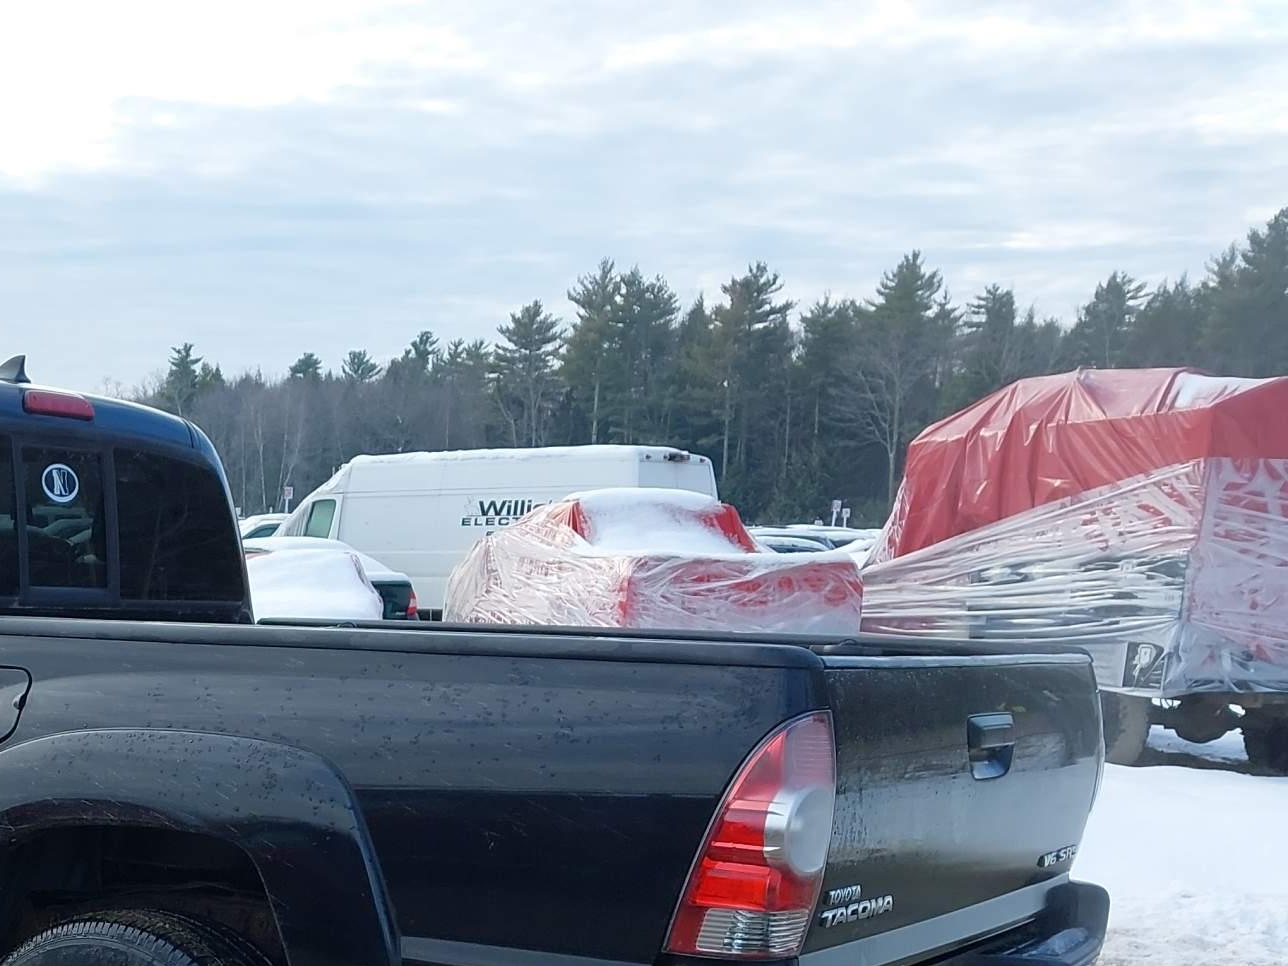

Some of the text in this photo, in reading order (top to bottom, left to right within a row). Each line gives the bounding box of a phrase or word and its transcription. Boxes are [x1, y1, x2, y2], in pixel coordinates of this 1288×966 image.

[479, 499, 546, 516] Willi
[829, 884, 862, 906] TOYOTA
[821, 894, 894, 929] TACOMA
